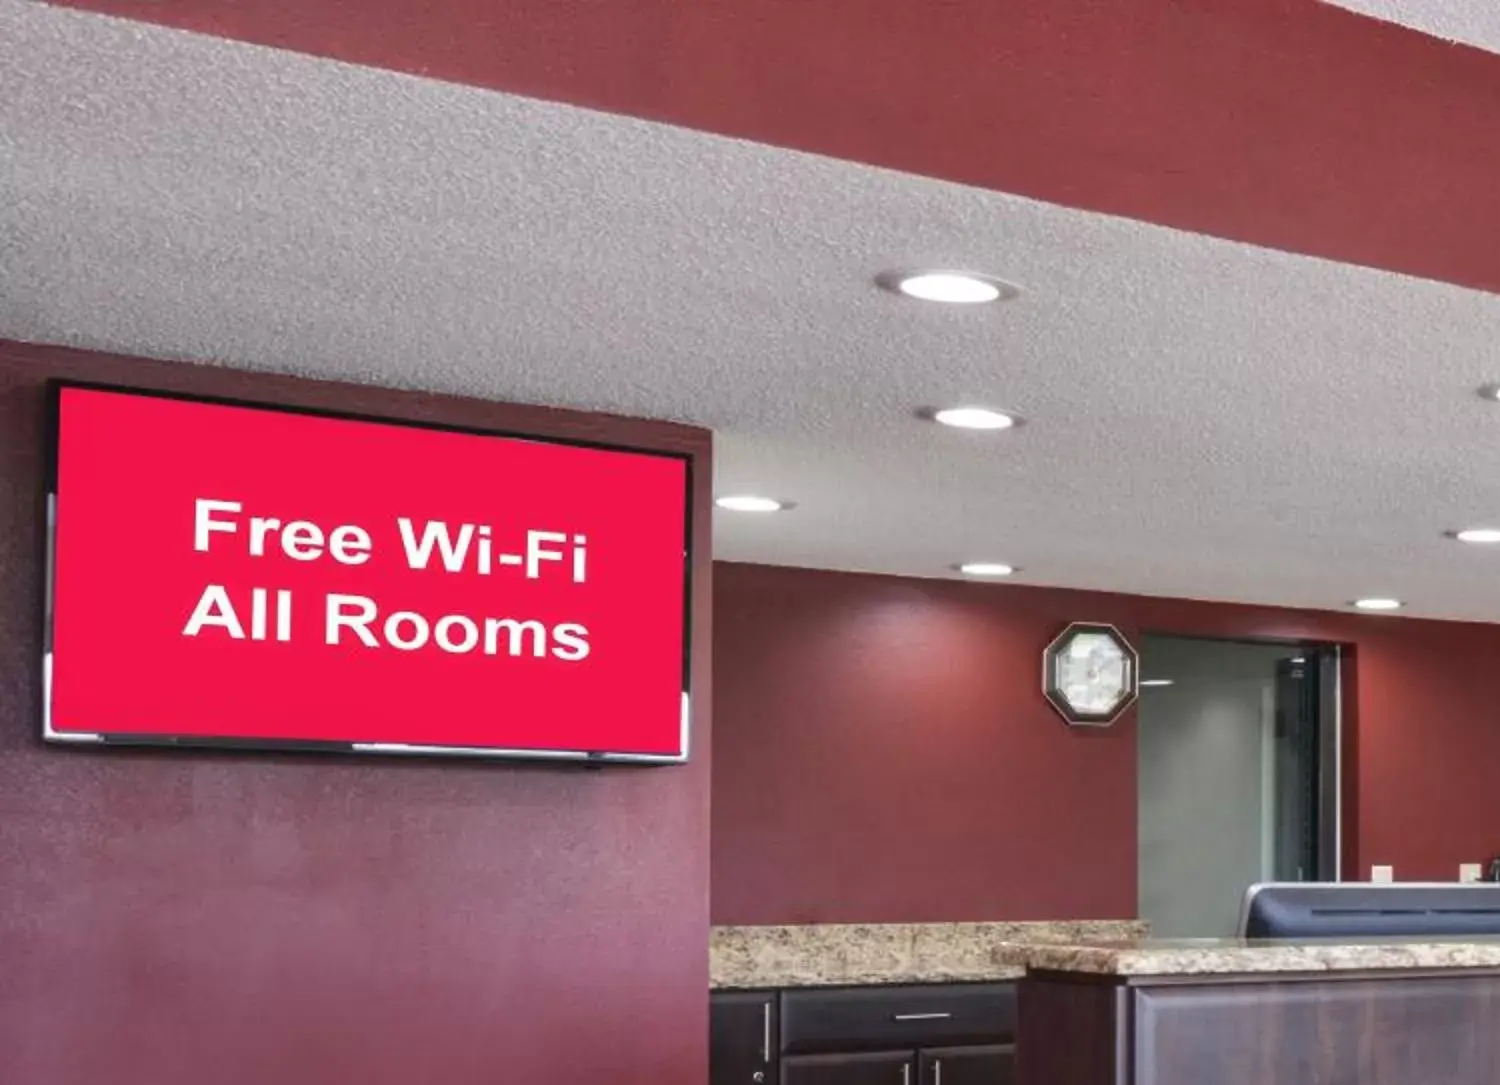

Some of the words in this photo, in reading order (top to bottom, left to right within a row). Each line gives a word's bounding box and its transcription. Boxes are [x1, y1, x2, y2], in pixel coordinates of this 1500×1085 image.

[193, 497, 373, 566] Free
[396, 516, 587, 584] Wi-Fi
[181, 583, 293, 643] All
[324, 592, 591, 662] Rooms
